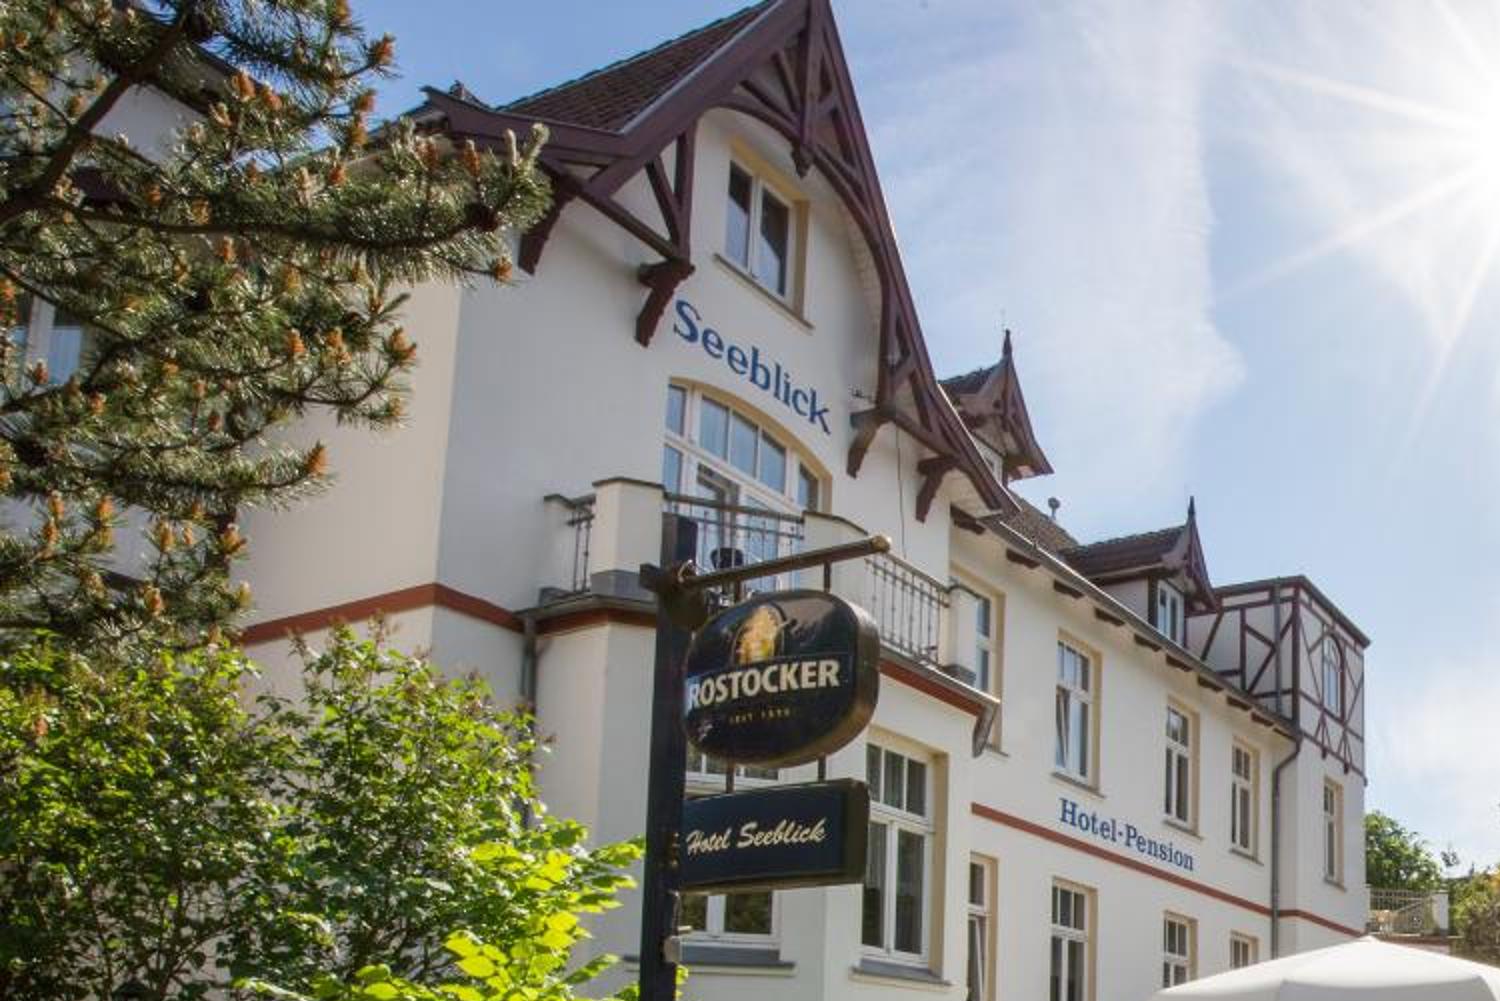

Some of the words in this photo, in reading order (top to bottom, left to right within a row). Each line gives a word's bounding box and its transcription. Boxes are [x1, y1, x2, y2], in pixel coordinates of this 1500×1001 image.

[673, 300, 831, 435] Seeblick
[687, 659, 840, 711] ROSTOCKER
[685, 828, 732, 856] Hotel
[736, 818, 827, 848] Seeblick
